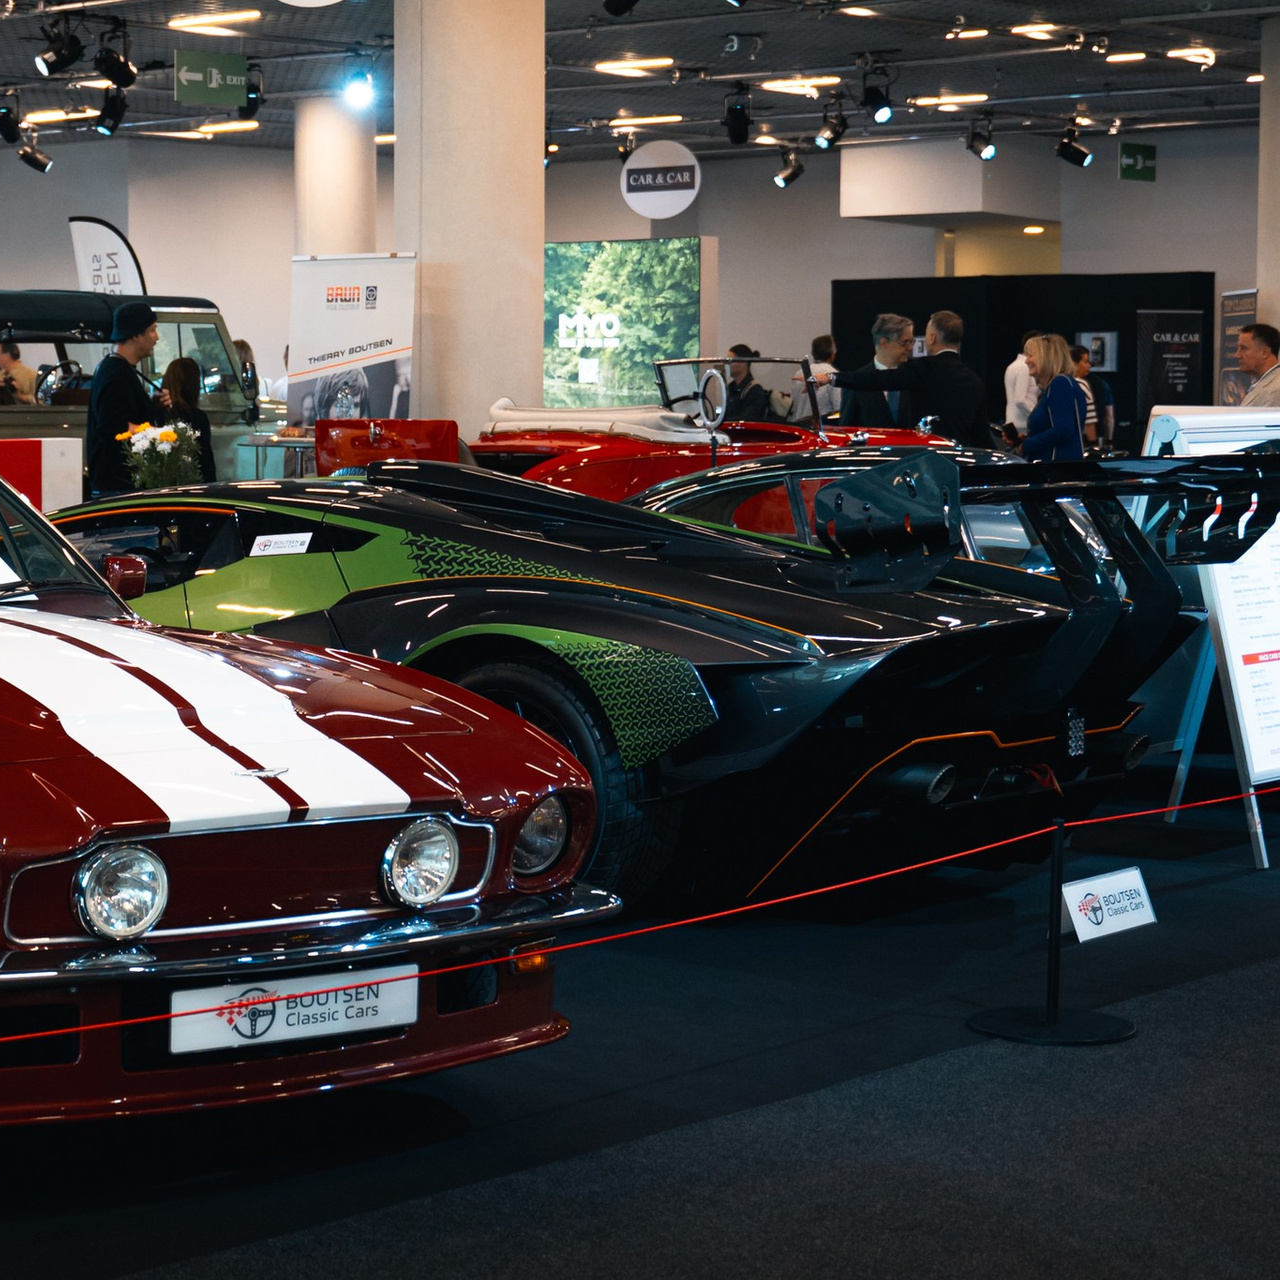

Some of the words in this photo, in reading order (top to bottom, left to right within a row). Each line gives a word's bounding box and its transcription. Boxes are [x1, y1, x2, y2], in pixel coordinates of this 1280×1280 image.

[226, 75, 246, 86] EXIT
[629, 173, 653, 186] CAR
[655, 173, 664, 185] &
[666, 171, 691, 184] CAR
[1153, 333, 1171, 342] CAR
[1173, 333, 1180, 342] &
[1181, 333, 1200, 342] CAR
[308, 349, 346, 365] THIERRY
[348, 338, 393, 355] BOUTSEN
[1102, 888, 1141, 907] BOUTSEN
[1106, 903, 1129, 917] Classic
[1130, 901, 1145, 912] Cars
[286, 984, 380, 1011] BOUTSEN
[285, 1009, 339, 1027] Classic
[345, 1003, 379, 1020] Cars
